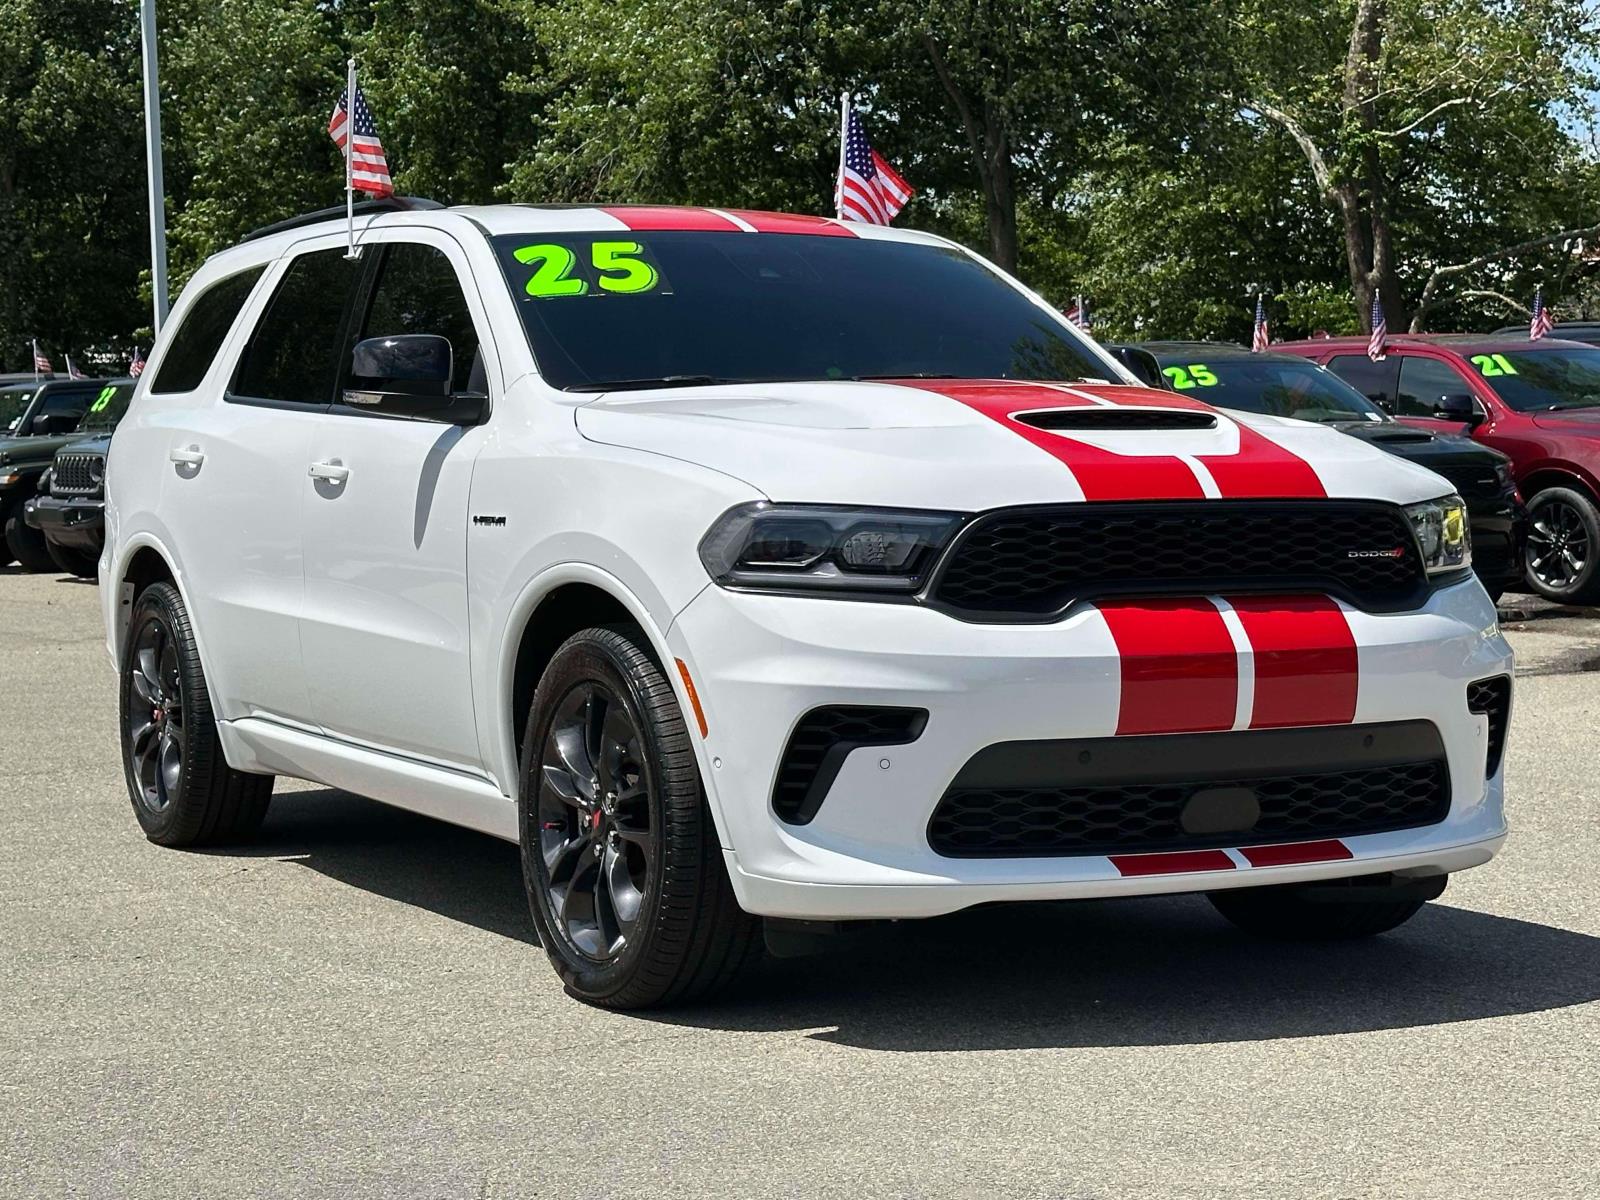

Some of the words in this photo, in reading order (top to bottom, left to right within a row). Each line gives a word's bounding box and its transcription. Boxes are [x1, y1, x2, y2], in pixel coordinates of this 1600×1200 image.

[512, 241, 660, 298] 25
[1162, 364, 1219, 390] 25
[1470, 353, 1519, 377] 21
[1347, 549, 1401, 558] DODGE
